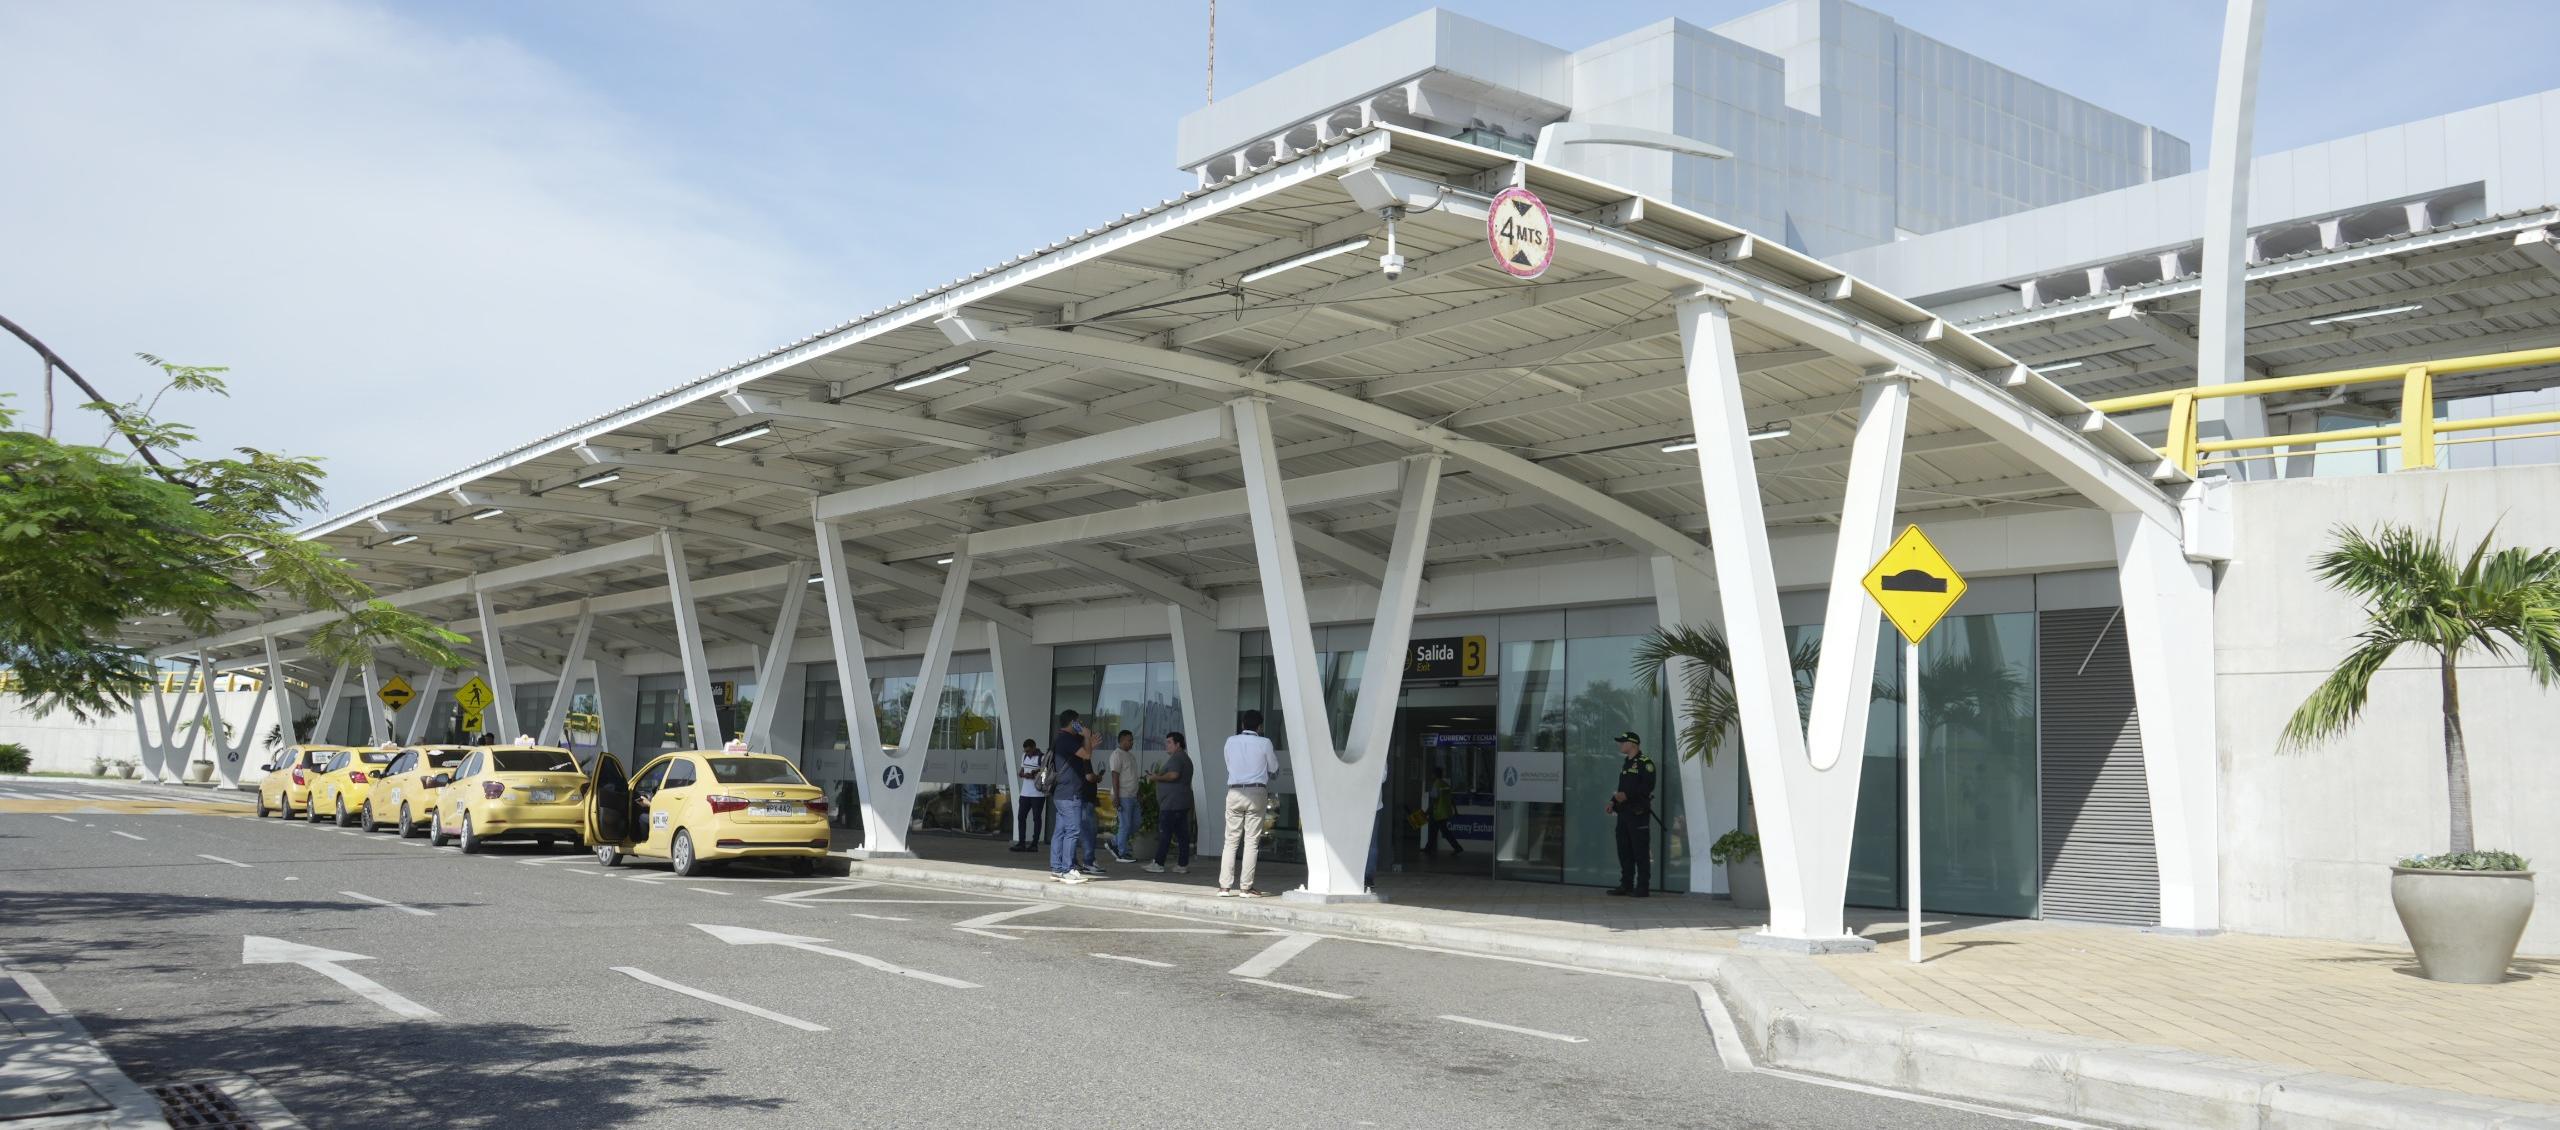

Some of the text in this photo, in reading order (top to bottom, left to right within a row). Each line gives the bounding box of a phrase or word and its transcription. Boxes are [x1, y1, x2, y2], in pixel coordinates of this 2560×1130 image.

[1500, 216, 1542, 245] 4 MTS
[1417, 641, 1480, 671] Salida 3
[1417, 662, 1430, 672] Exit
[1446, 822, 1472, 834] Currency
